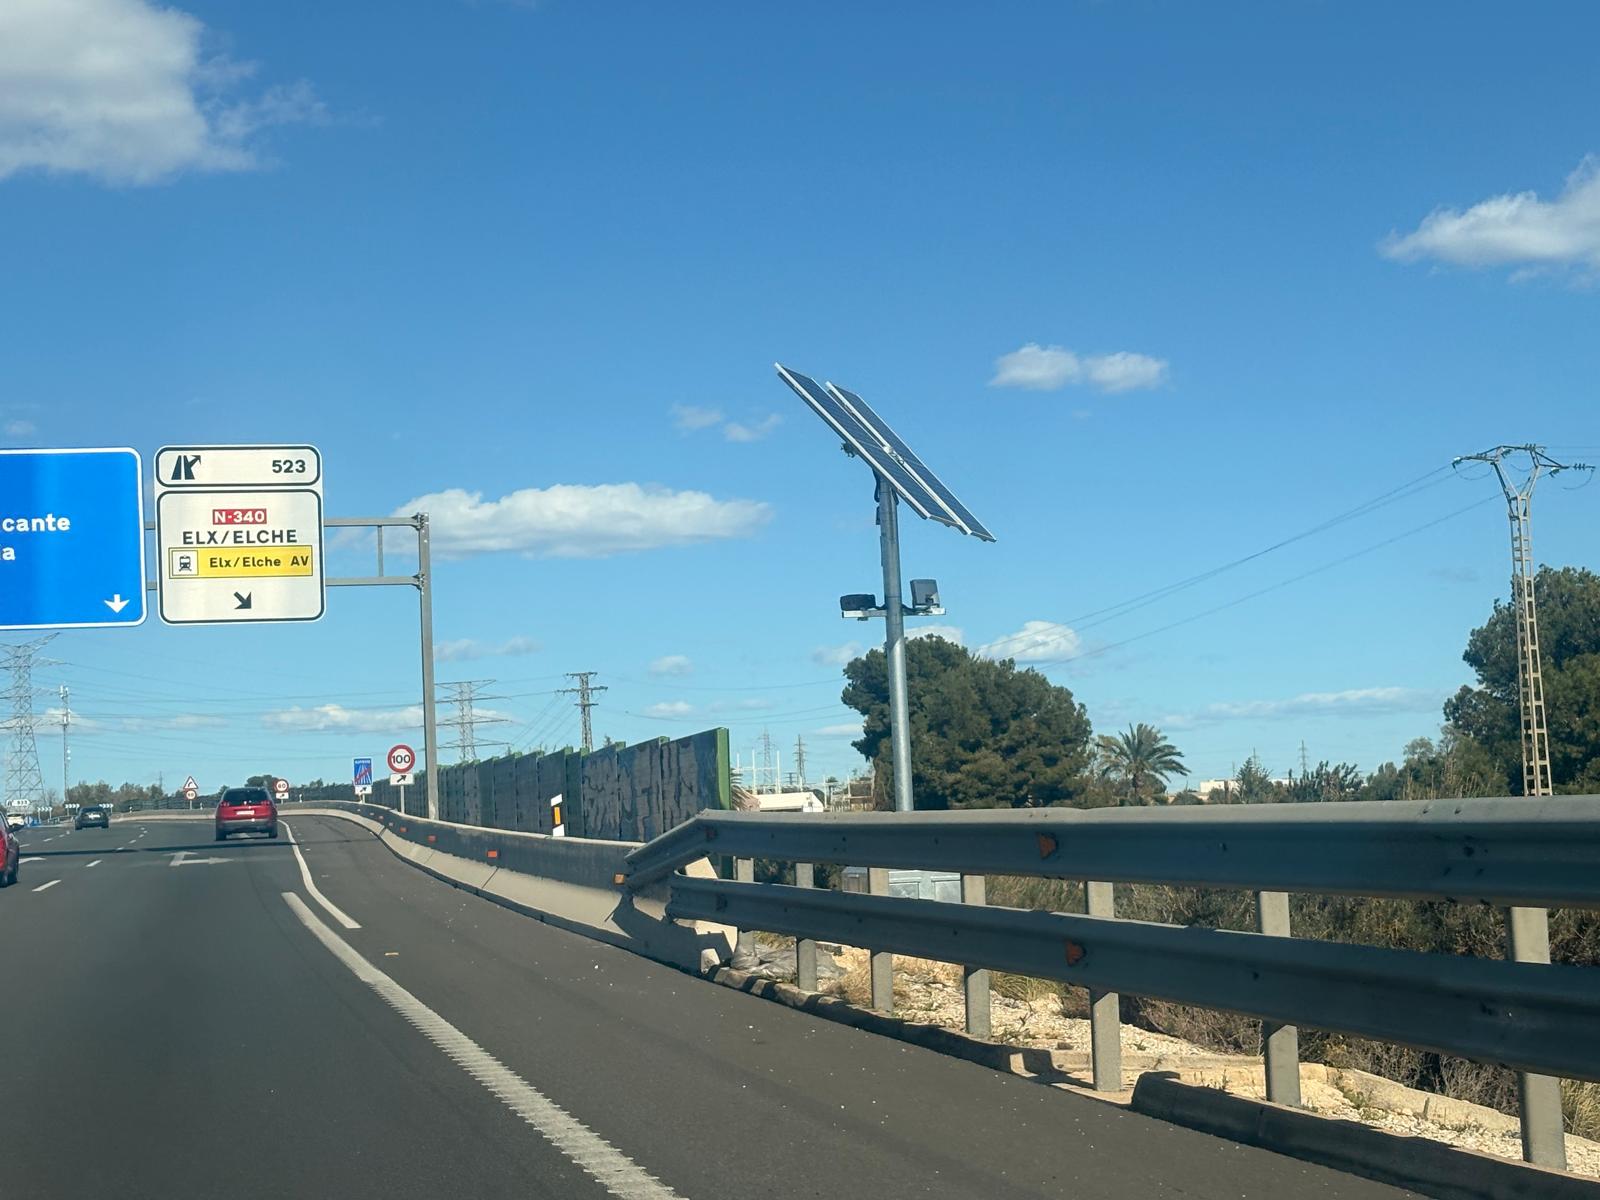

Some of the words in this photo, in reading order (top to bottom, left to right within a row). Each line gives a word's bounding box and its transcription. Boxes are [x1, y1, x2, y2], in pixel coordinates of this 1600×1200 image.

[272, 459, 306, 474] 523
[2, 513, 71, 532] cante
[214, 510, 265, 524] N-340
[182, 529, 298, 545] ELX/ELCHE
[209, 556, 281, 568] Elx/Elche
[290, 555, 309, 566] AV
[392, 754, 411, 764] 100
